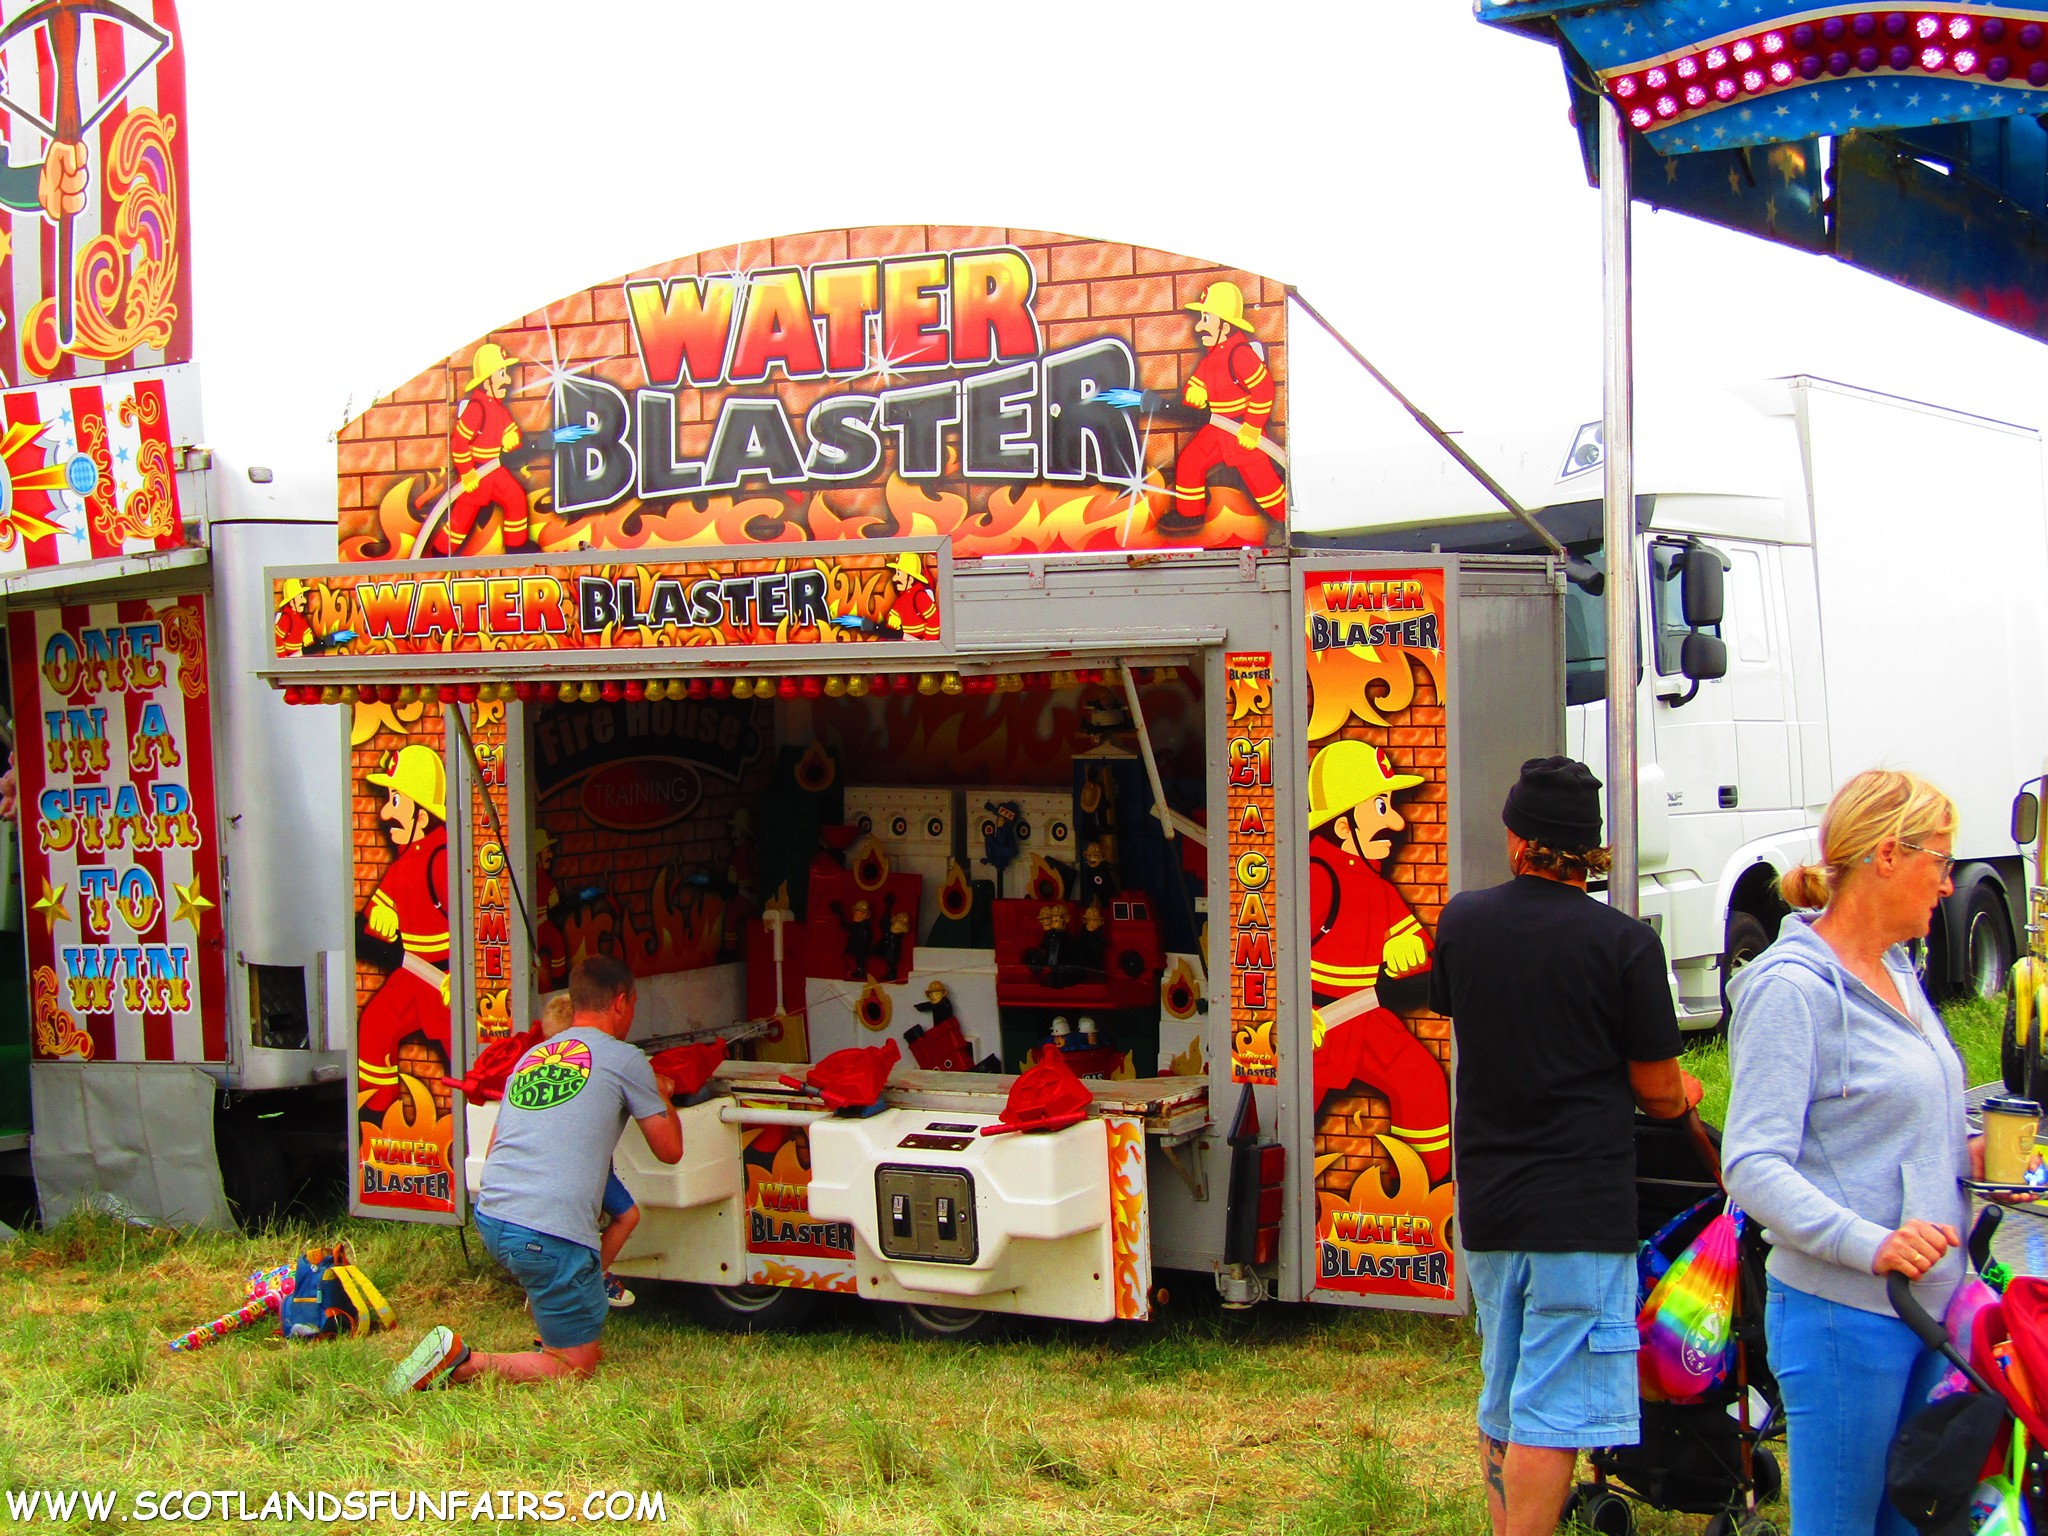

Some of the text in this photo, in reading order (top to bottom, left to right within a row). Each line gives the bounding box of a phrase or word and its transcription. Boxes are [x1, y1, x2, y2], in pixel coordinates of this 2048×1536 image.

[625, 246, 1039, 388] WATER
[554, 337, 1141, 513] BLASTER
[356, 569, 830, 638] WATER BLASTER
[1321, 580, 1425, 612] WATER
[1311, 612, 1439, 652] BLASTER
[42, 620, 165, 698] ONE
[1229, 668, 1271, 681] BLASTER
[45, 702, 182, 774] IN A
[538, 699, 743, 766] Fire House
[38, 782, 202, 853] STAR
[593, 777, 689, 810] TRAINING
[1228, 736, 1275, 1009] £1 A GAME
[79, 865, 162, 934] TO
[63, 943, 191, 1015] WIN
[1235, 1064, 1277, 1079] BLASTER
[370, 1138, 440, 1168] WATER
[363, 1161, 451, 1201] BLASTER
[758, 1182, 809, 1213] WAT
[750, 1209, 856, 1253] BLASTER
[1331, 1210, 1434, 1246] WATER
[1320, 1240, 1449, 1288] BLASTER
